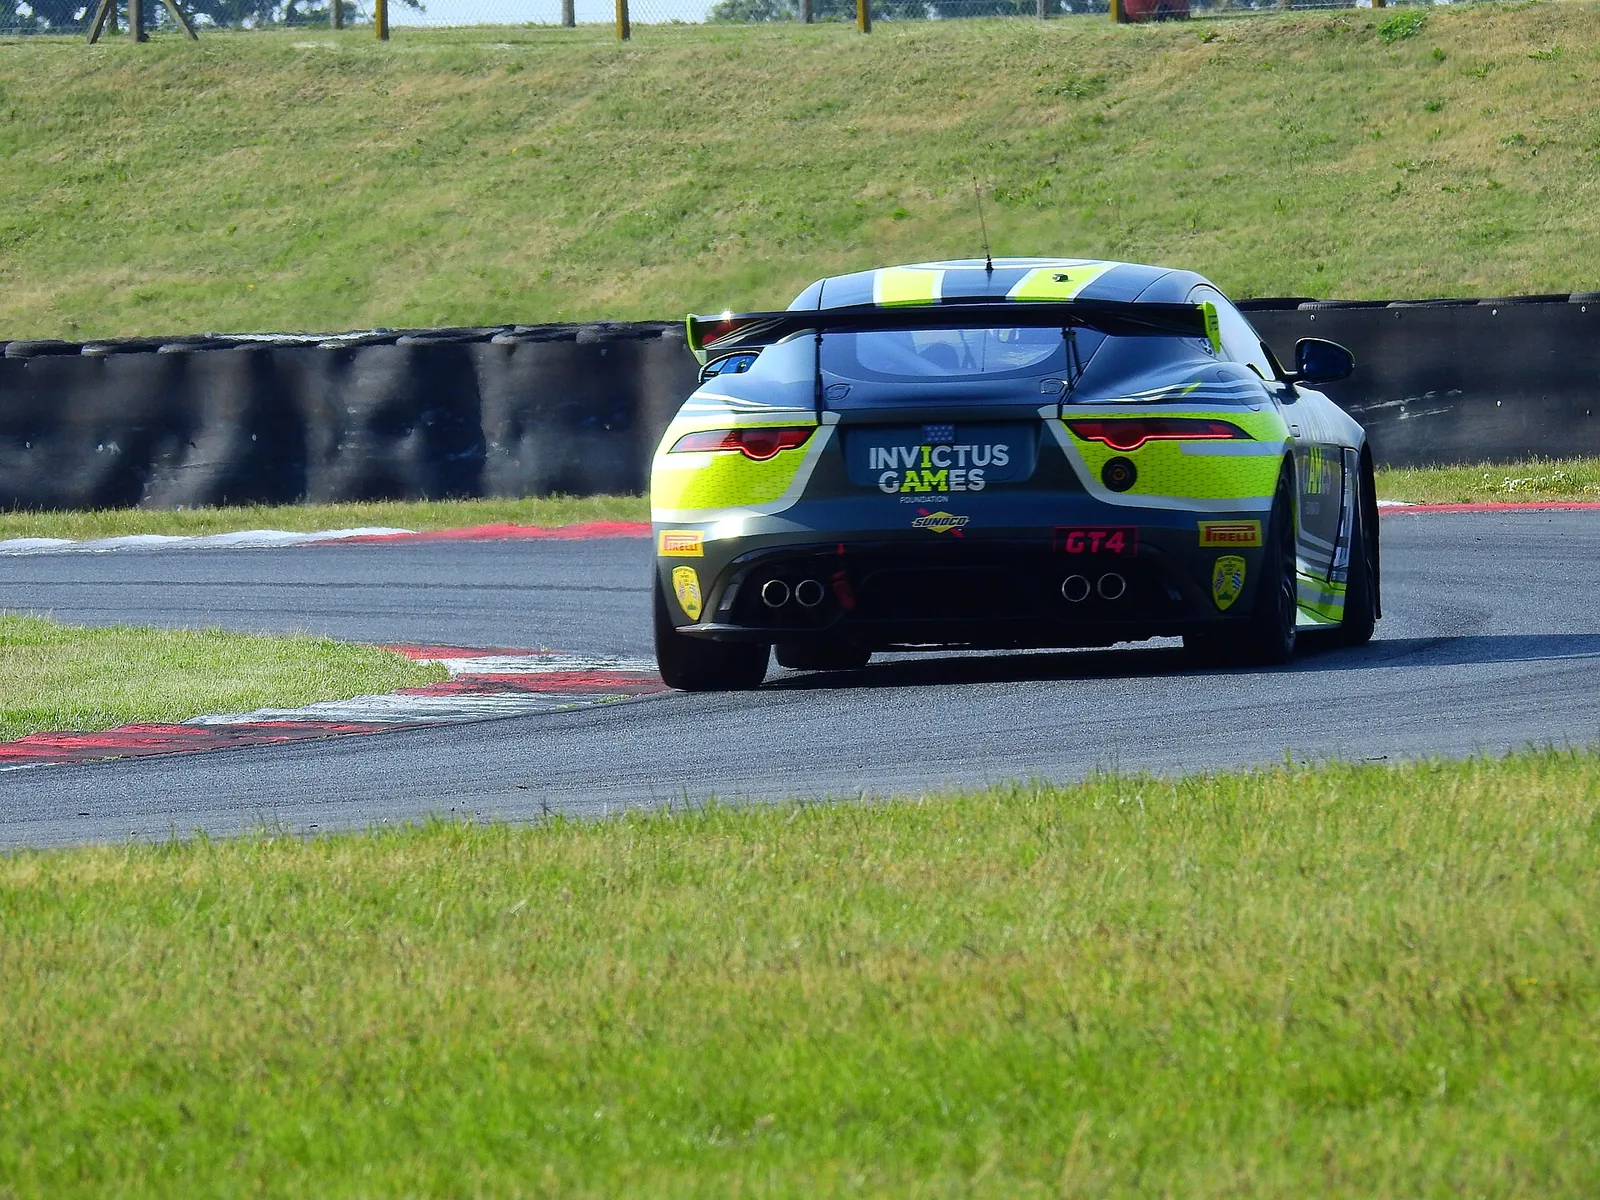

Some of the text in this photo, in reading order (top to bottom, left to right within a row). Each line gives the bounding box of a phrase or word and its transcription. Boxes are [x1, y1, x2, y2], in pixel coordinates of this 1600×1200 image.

[869, 444, 1010, 469] INVICTUS
[878, 469, 986, 494] GAMES
[913, 516, 968, 527] SUNOCO
[1065, 531, 1126, 553] GT4
[1204, 525, 1256, 542] PIRELLI
